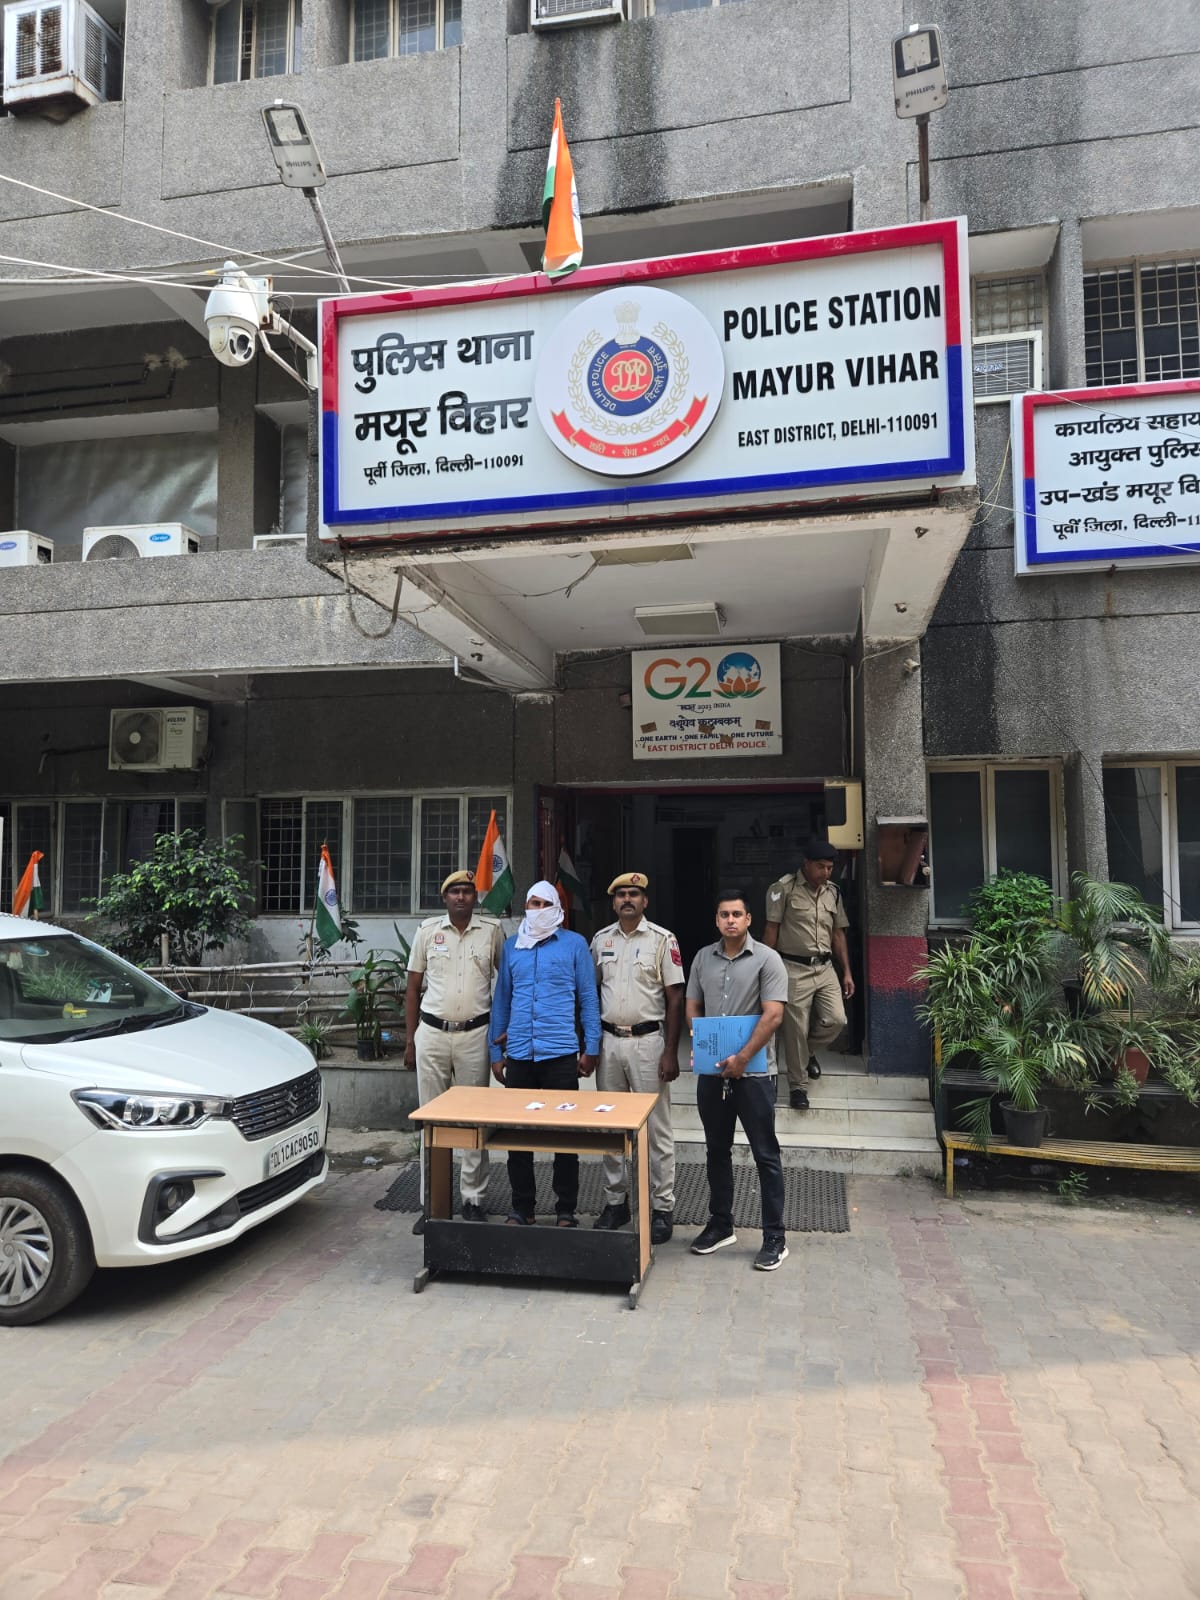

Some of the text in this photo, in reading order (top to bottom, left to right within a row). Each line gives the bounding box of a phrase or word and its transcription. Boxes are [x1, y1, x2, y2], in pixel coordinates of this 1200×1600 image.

[905, 84, 936, 98] PHILIPS
[723, 284, 941, 342] POLICE STATION
[351, 330, 534, 394] पुलिस थाना
[733, 350, 939, 400] MAYUR VIHAR
[591, 351, 617, 411] DELHI POLICE
[354, 390, 532, 455] मयूर विहार
[738, 412, 938, 448] EAST DISTRICT, DELHI-110091
[1055, 414, 1141, 437] कार्यालय
[363, 454, 524, 485] पूर्वी जिला, दिल्ली-110091
[1069, 446, 1142, 471] आयुक्त
[1040, 481, 1120, 506] उप-खंड
[1126, 481, 1174, 504] मयूर
[670, 743, 707, 751] DISTRICT
[737, 740, 767, 748] POLICE
[273, 1131, 318, 1168] DL1CAC9050
